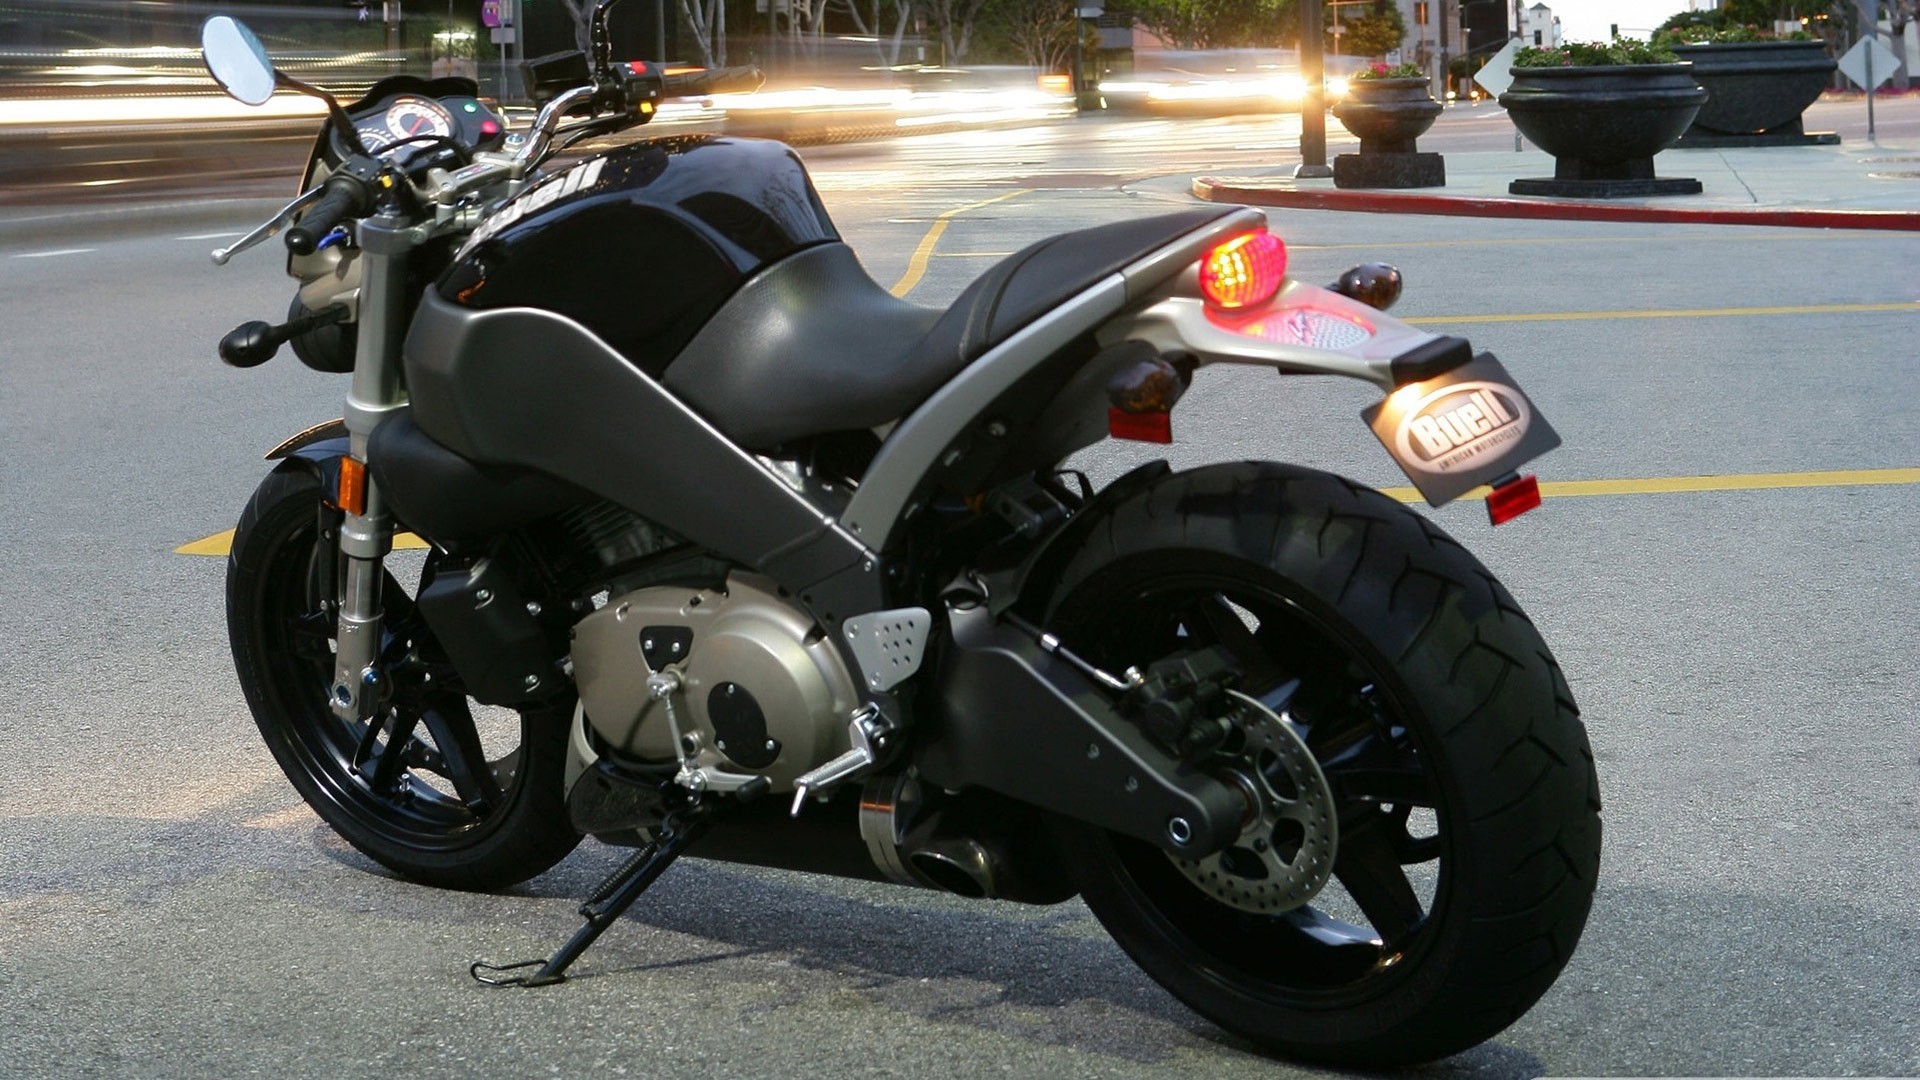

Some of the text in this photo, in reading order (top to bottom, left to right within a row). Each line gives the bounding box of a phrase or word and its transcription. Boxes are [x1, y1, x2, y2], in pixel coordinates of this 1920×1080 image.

[1410, 389, 1512, 457] Buell
[1439, 425, 1521, 471] AMERICAN MOTORCYCLES
